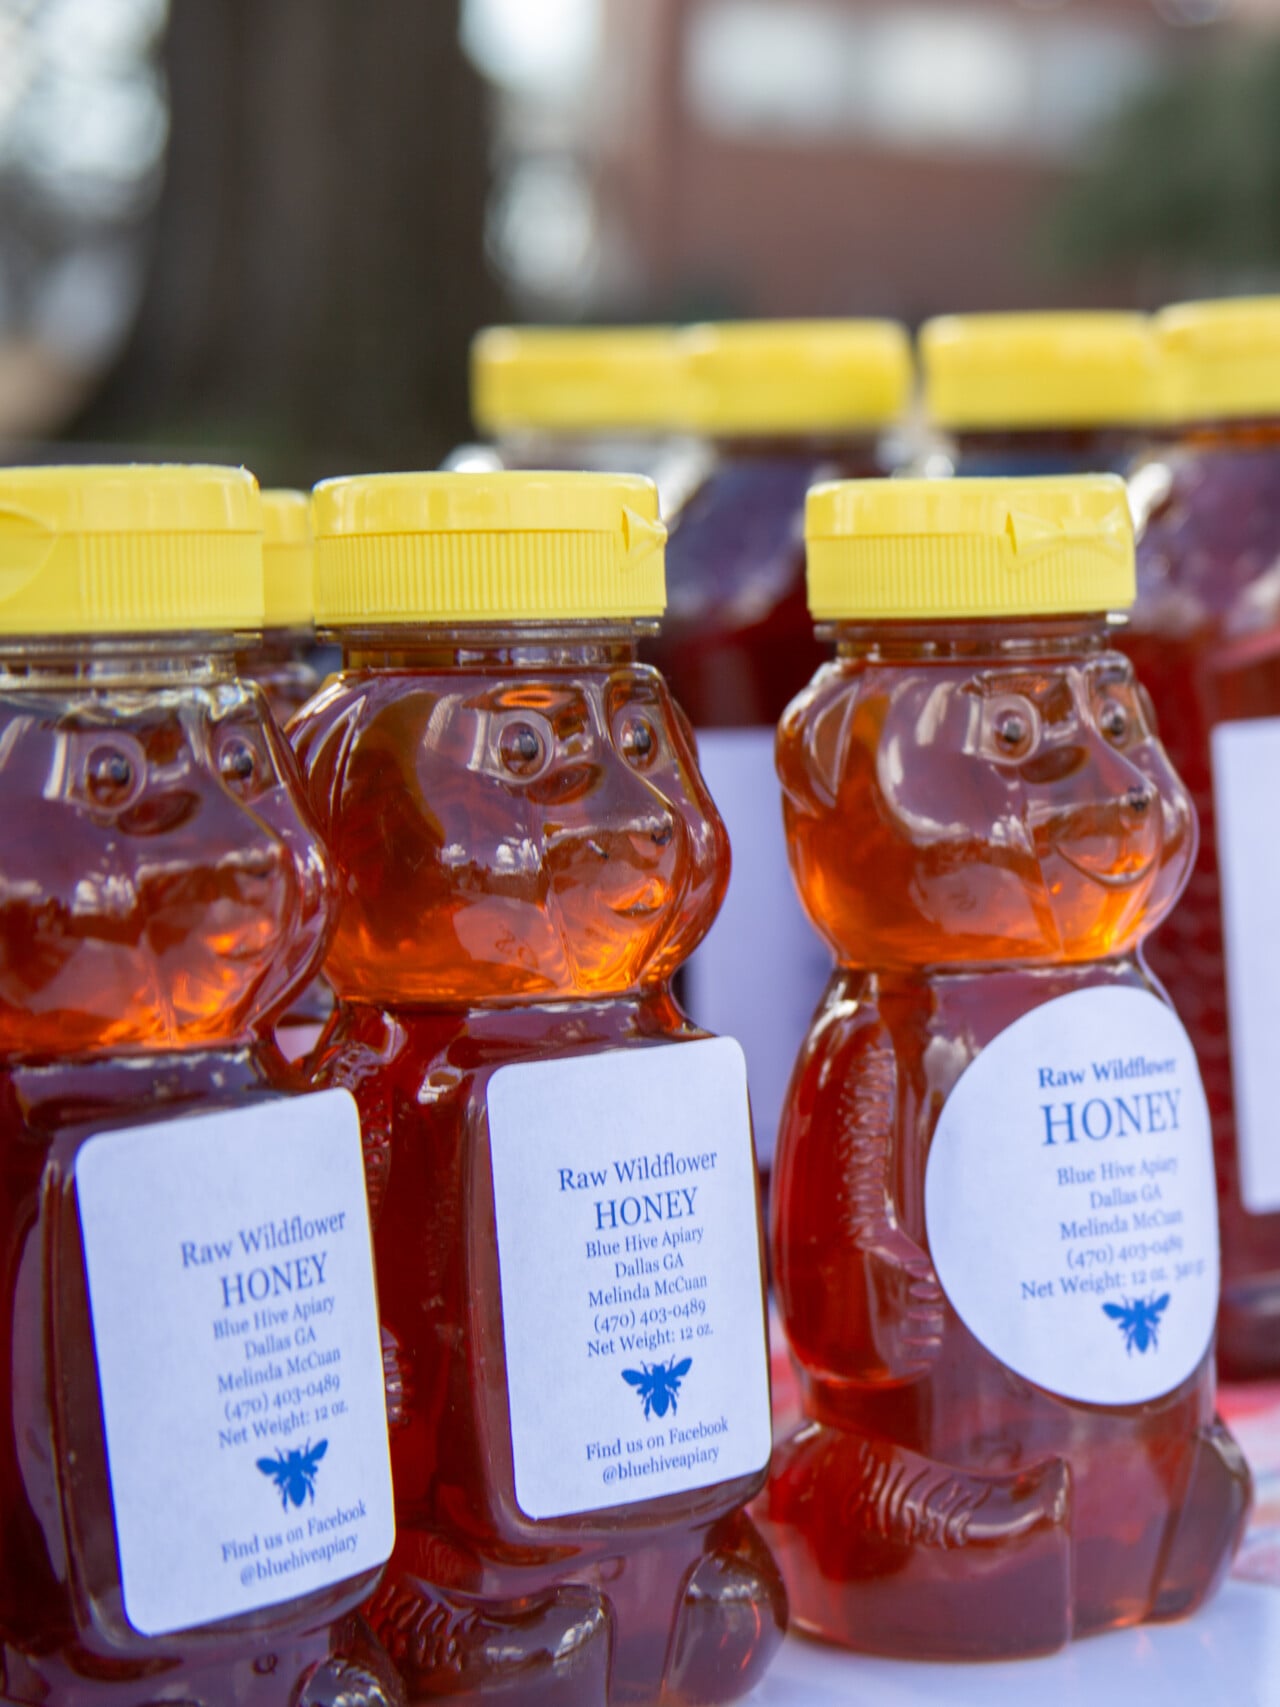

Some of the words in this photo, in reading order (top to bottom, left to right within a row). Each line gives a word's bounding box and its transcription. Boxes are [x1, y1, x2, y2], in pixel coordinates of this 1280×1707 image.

[1037, 1066, 1085, 1089] Raw
[1091, 1056, 1176, 1081] Wildflower
[1041, 1088, 1180, 1146] HONEY
[557, 1168, 608, 1191] Raw
[613, 1151, 718, 1184] Wildflower
[1057, 1166, 1096, 1186] Blue
[1100, 1161, 1136, 1181] Hive
[594, 1186, 698, 1231] HONEY
[1090, 1187, 1138, 1209] Dallas
[1141, 1183, 1162, 1201] GA
[180, 1240, 233, 1269] Raw
[238, 1211, 346, 1255] Wildflower
[586, 1239, 620, 1259] Blue
[625, 1233, 658, 1252] Hive
[662, 1227, 704, 1249] Apiary
[1059, 1214, 1128, 1240] Melinda
[615, 1257, 660, 1278] Dallas
[663, 1252, 684, 1270] GA
[1066, 1243, 1114, 1270] (470)
[220, 1251, 328, 1309] HONEY
[588, 1283, 650, 1308] Melinda
[655, 1275, 708, 1297] McCuan
[1020, 1279, 1054, 1300] Net
[1060, 1270, 1127, 1296] Weight:
[1131, 1269, 1147, 1285] 12
[212, 1318, 249, 1340] Blue
[254, 1307, 289, 1331] Hive
[293, 1296, 335, 1322] Apiary
[594, 1309, 636, 1334] (470)
[640, 1297, 706, 1326] 403-0489
[244, 1333, 292, 1360] Dallas
[294, 1325, 316, 1346] GA
[587, 1339, 615, 1358] Net
[620, 1328, 675, 1352] Weight:
[681, 1326, 694, 1341] 12
[697, 1323, 714, 1337] oz.
[217, 1361, 283, 1393] Melinda
[287, 1347, 341, 1376] McCuan
[224, 1391, 269, 1422] (470)
[273, 1373, 341, 1409] 403-0489
[218, 1427, 248, 1449] Net
[252, 1409, 311, 1438] Weight:
[314, 1405, 329, 1422] 12
[331, 1399, 349, 1417] oz.
[586, 1437, 622, 1461] Find
[626, 1438, 643, 1453] us
[647, 1435, 665, 1449] on
[669, 1415, 729, 1445] Facebook
[602, 1446, 720, 1486] @bluehiveapiary
[221, 1533, 260, 1563] Find
[264, 1532, 283, 1551] us
[286, 1526, 304, 1544] on
[307, 1499, 367, 1537] Facebook
[239, 1533, 358, 1587] @bluehiveapiary
